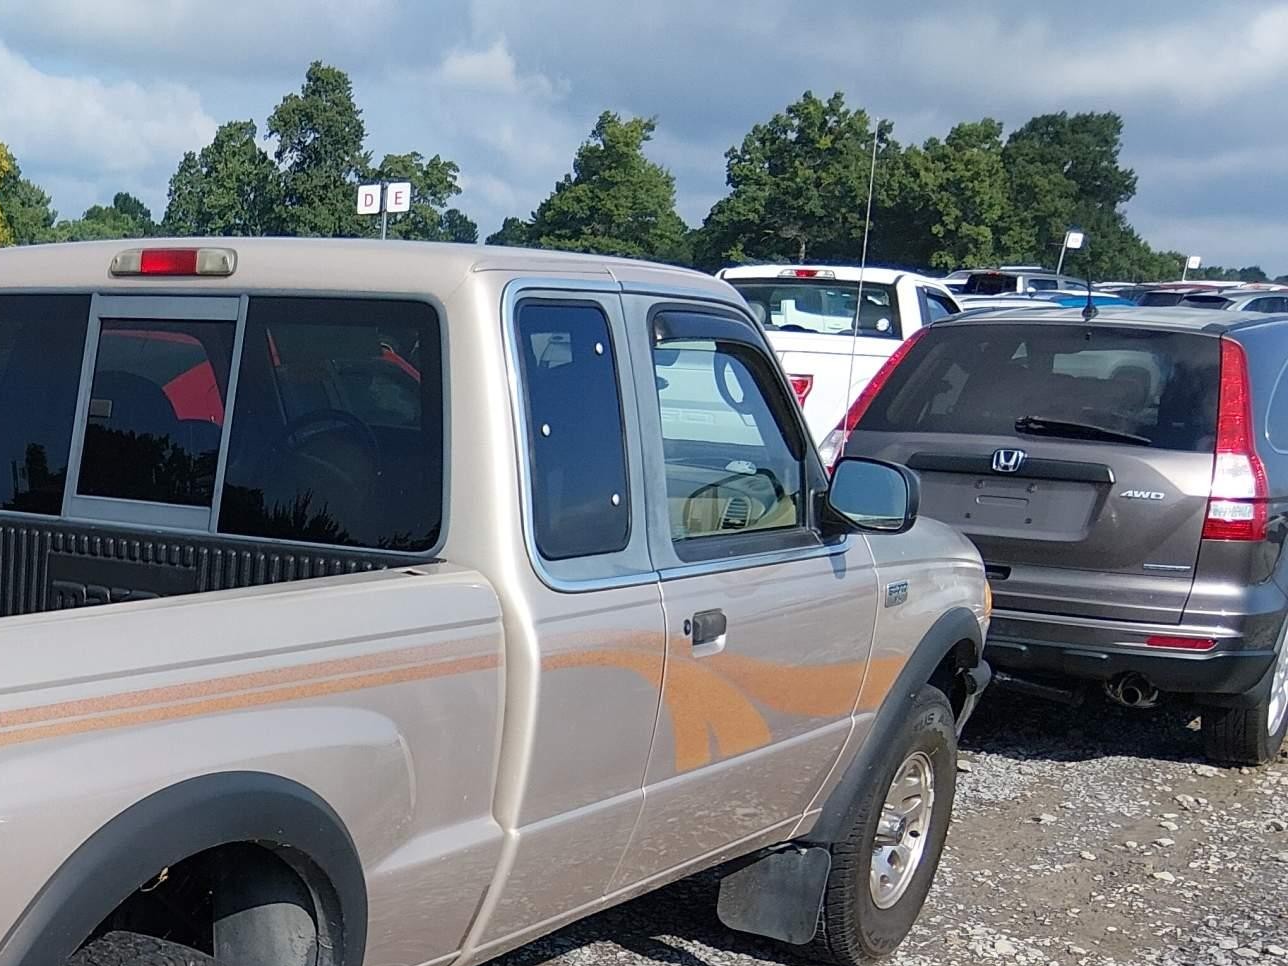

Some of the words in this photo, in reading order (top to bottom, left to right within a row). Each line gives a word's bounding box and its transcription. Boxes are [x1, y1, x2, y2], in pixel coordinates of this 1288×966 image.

[364, 193, 374, 207] D
[394, 191, 404, 205] E
[1119, 489, 1165, 501] AWD
